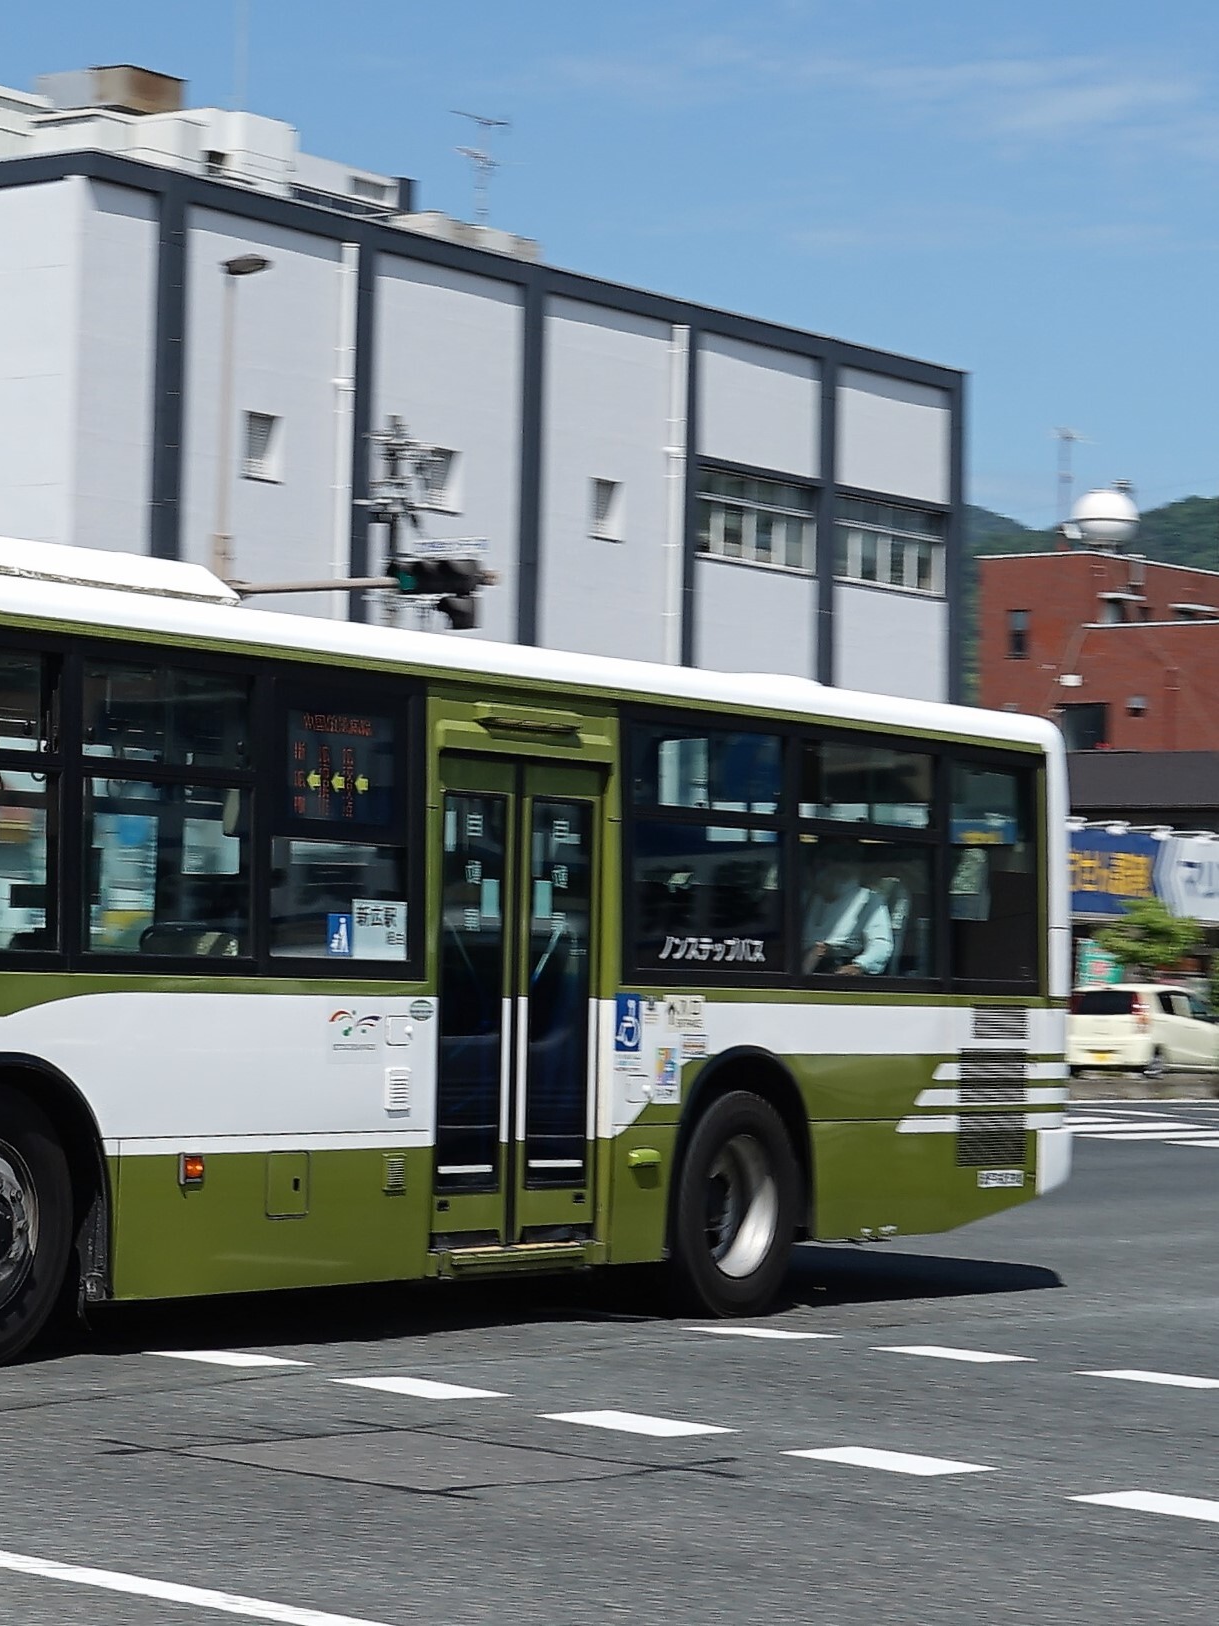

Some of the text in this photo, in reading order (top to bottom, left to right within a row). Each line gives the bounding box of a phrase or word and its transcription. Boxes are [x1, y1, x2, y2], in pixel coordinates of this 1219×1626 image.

[658, 935, 766, 962] ノンステップバス
